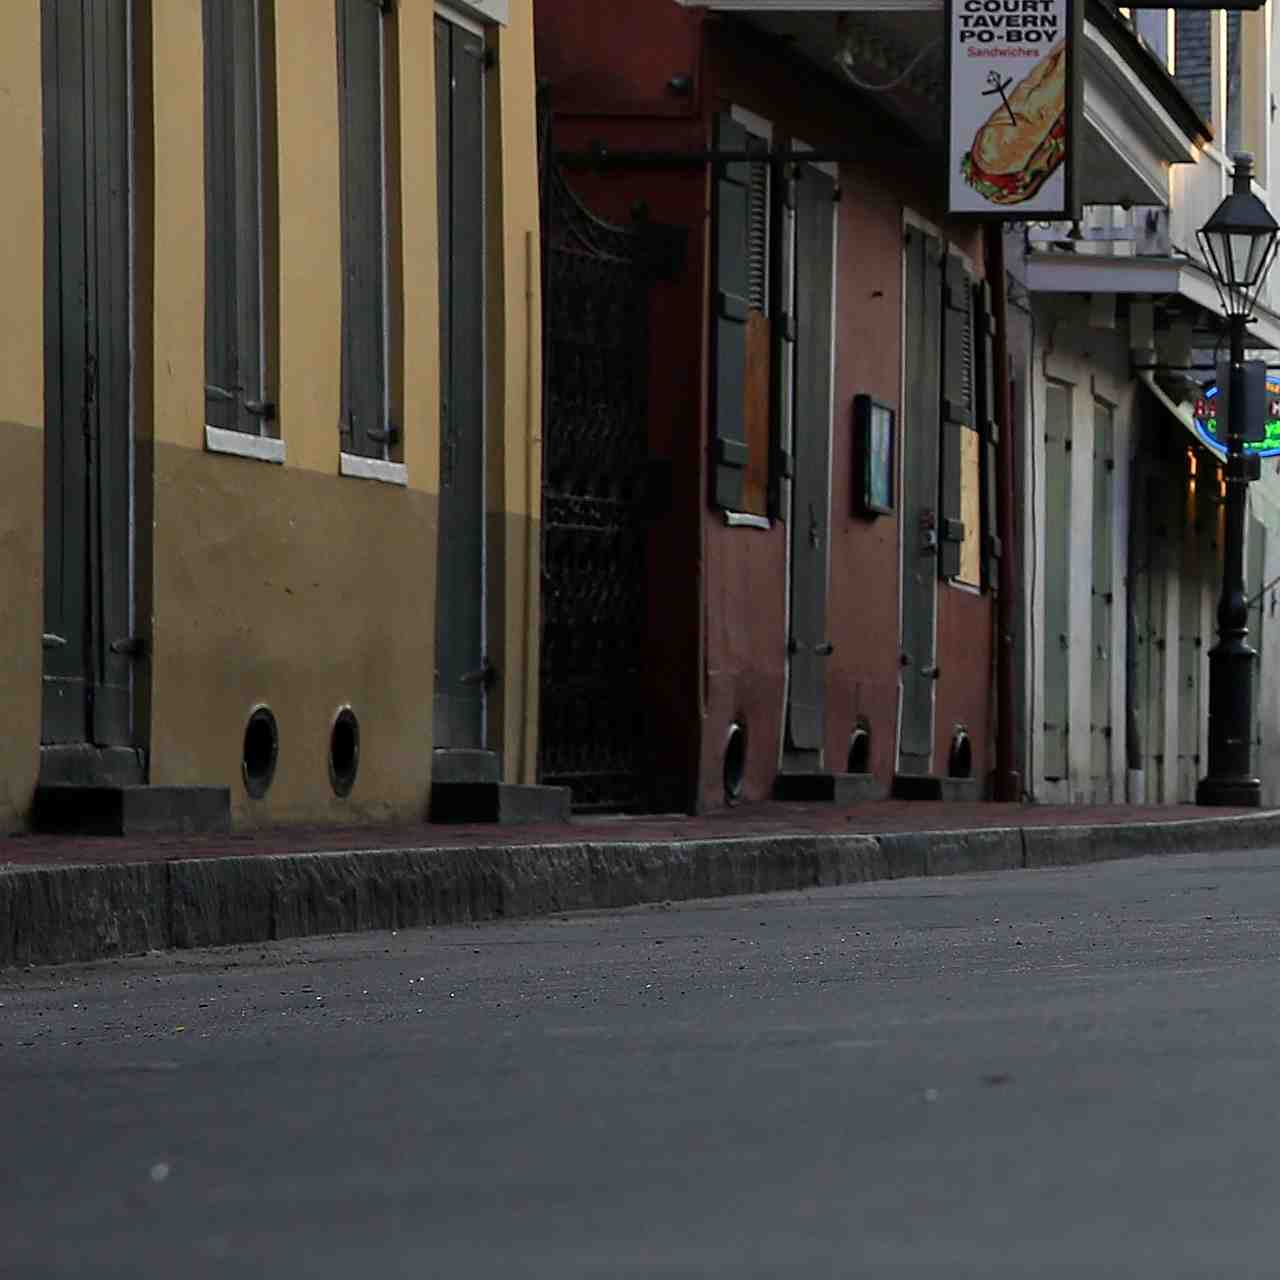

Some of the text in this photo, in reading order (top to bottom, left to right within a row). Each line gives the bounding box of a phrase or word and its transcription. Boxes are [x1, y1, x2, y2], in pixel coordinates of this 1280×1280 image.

[964, 0, 1054, 12] COURT
[959, 15, 1057, 27] TAVERN
[959, 29, 1057, 43] PO-BOY
[967, 47, 1040, 57] Sandwiches
